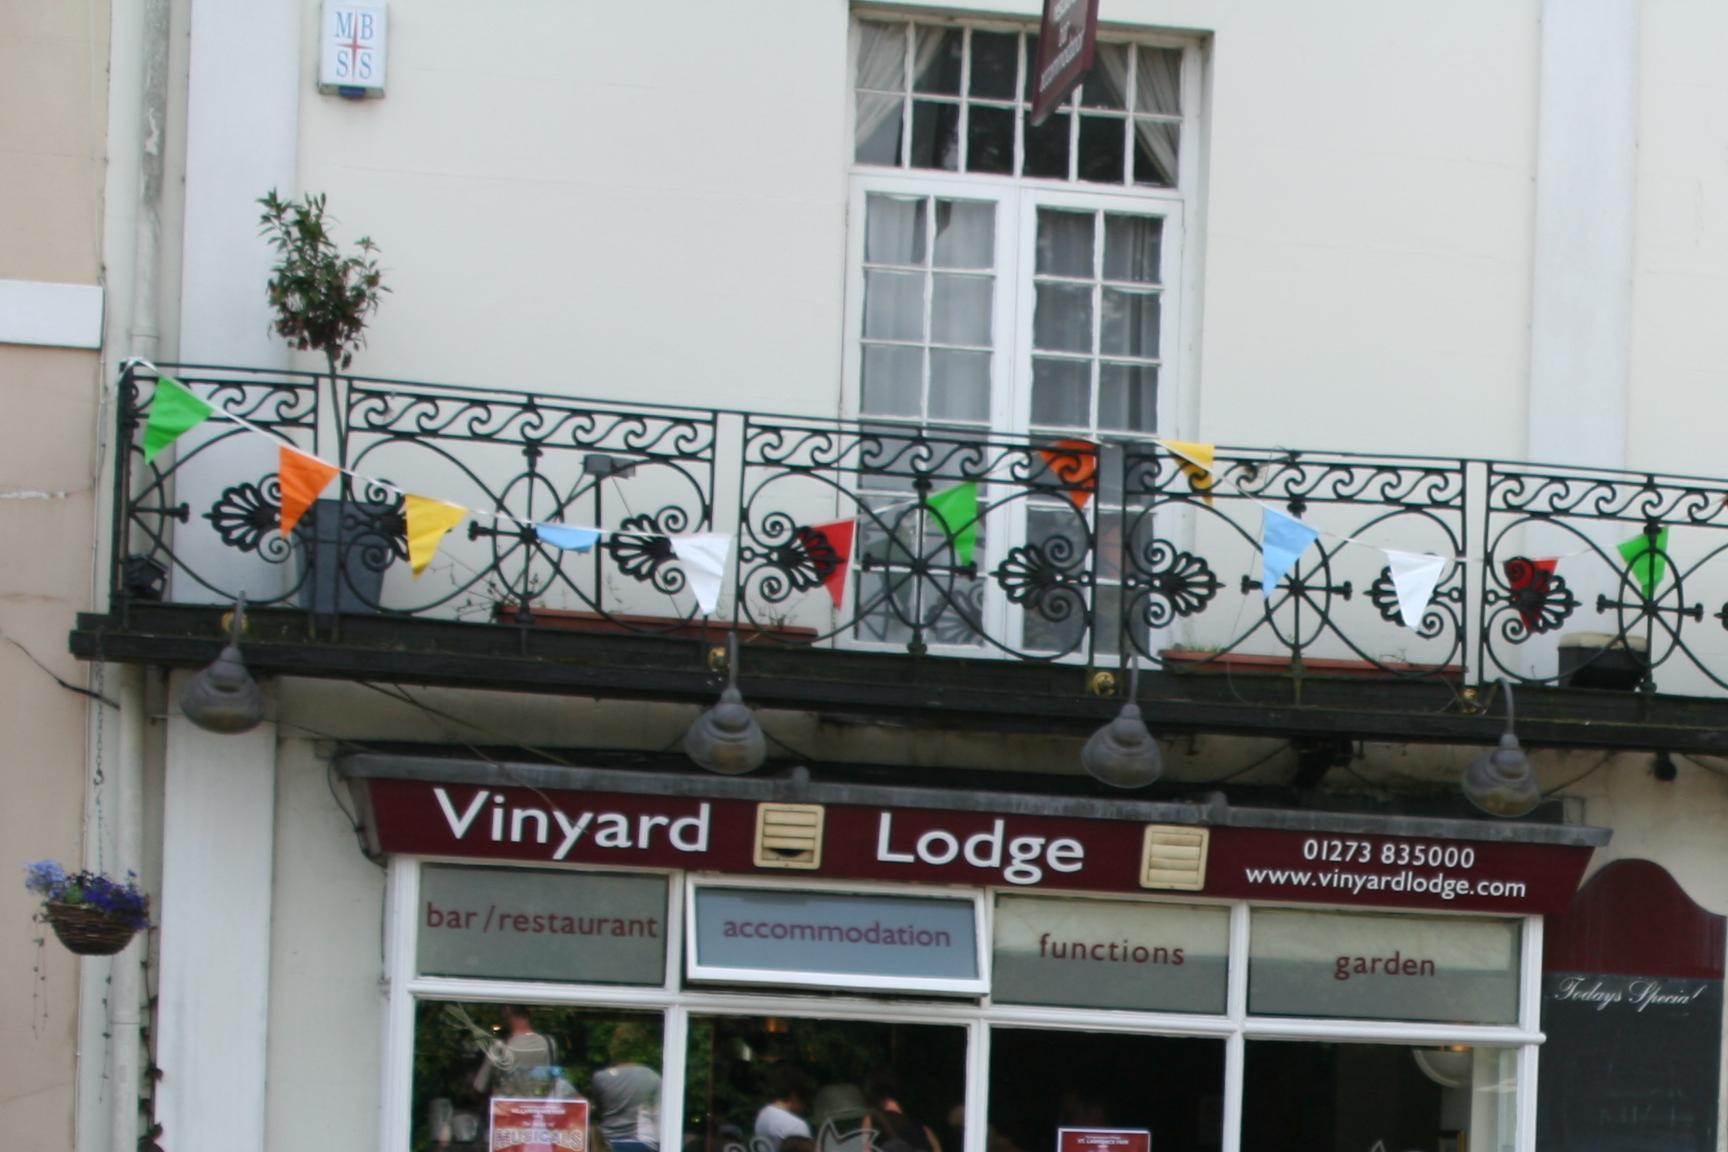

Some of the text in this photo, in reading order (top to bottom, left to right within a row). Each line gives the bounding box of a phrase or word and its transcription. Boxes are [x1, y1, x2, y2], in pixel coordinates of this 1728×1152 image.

[433, 787, 1085, 885] Vinyard Lodge
[1303, 838, 1475, 869] 01273 835000
[1245, 866, 1526, 899] www.vinyardlodge.com
[723, 914, 951, 948] accommodation
[1038, 932, 1185, 967] functions
[1333, 950, 1436, 981] garden
[1554, 976, 1622, 1011] Todays
